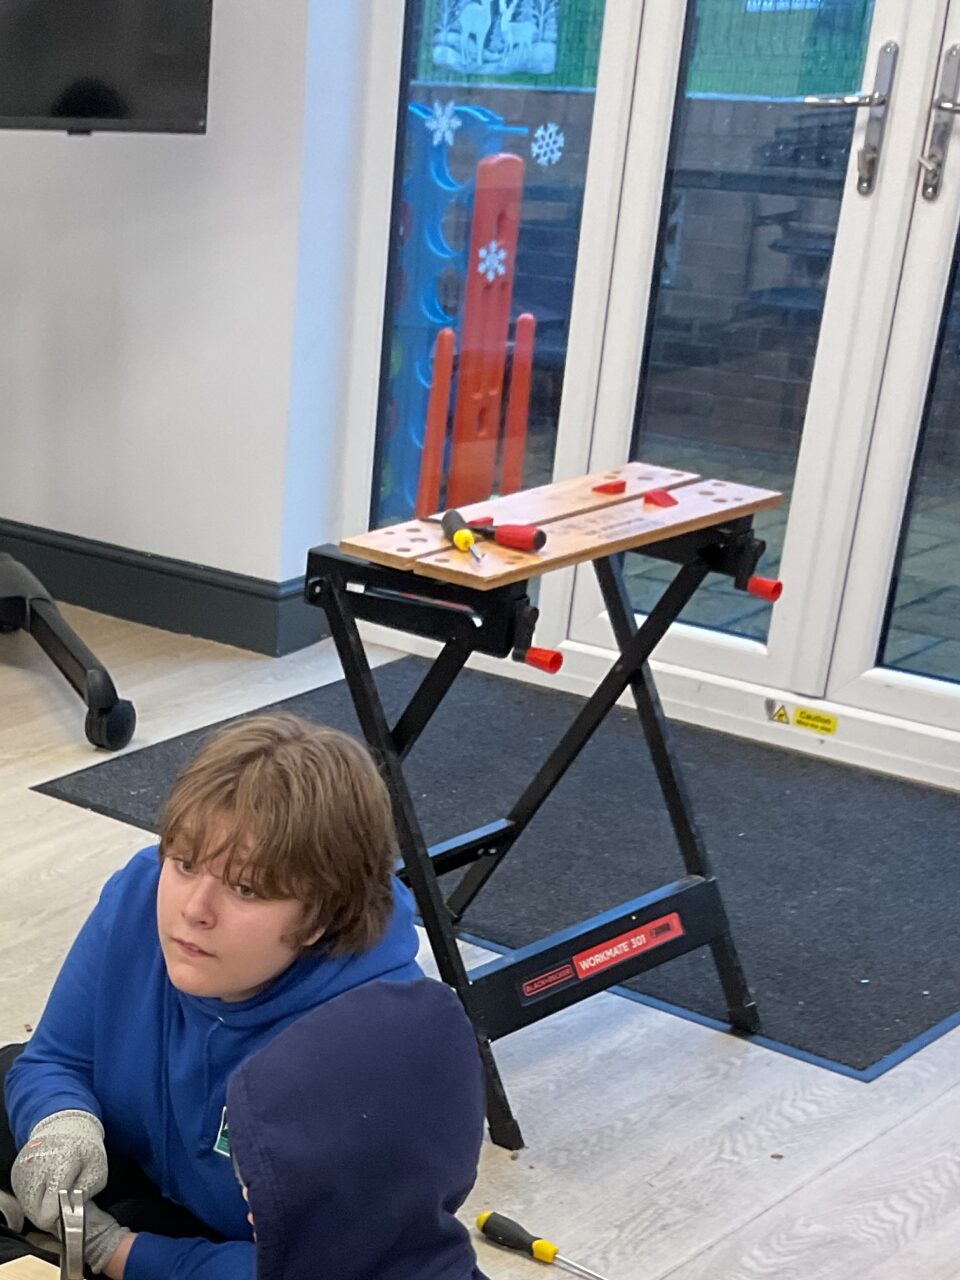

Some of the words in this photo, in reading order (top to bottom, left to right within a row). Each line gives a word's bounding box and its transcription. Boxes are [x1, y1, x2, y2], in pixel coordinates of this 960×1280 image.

[800, 711, 832, 725] Caution
[579, 942, 629, 971] WORKMATE
[631, 934, 647, 949] 301
